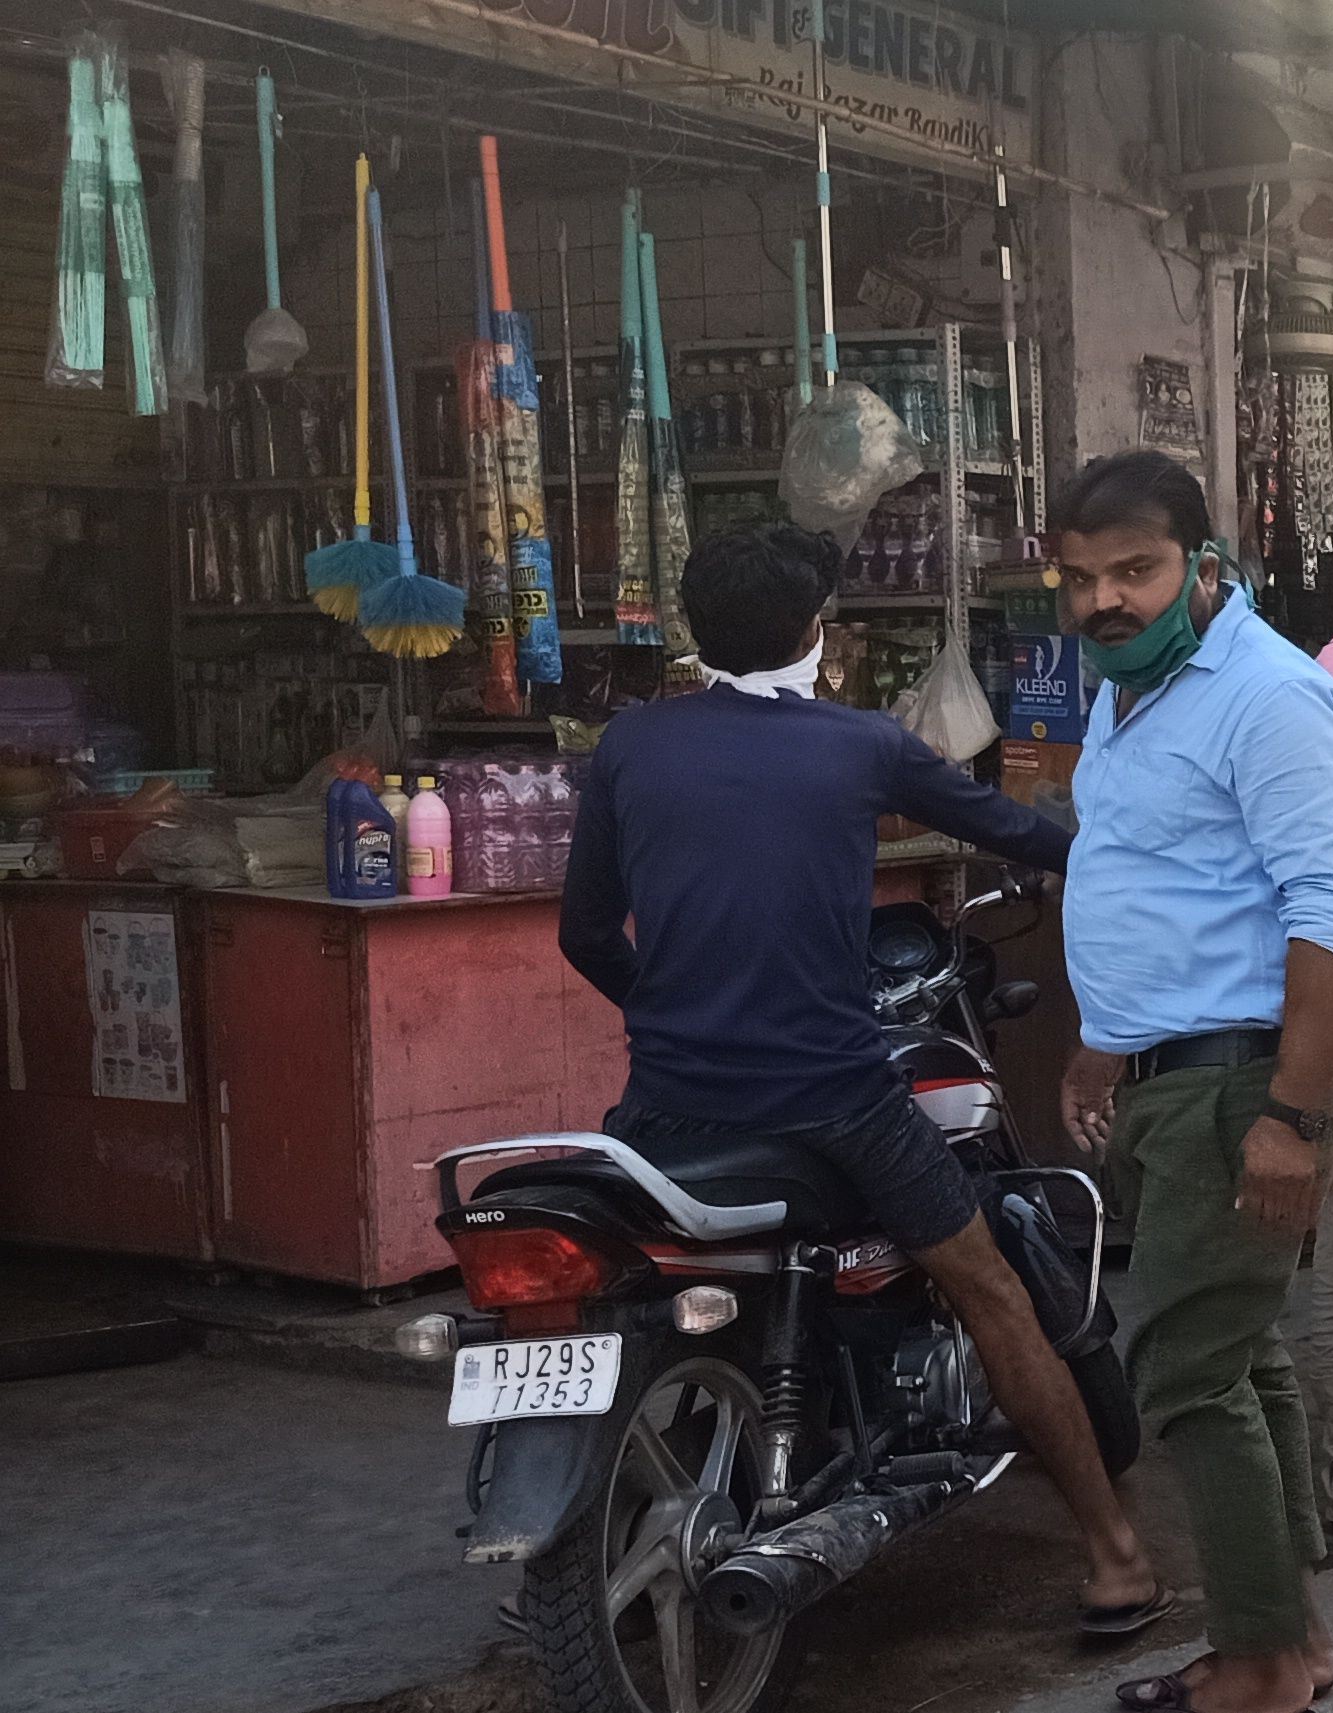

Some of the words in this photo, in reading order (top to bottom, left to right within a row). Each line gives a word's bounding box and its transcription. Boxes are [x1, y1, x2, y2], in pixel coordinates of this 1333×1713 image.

[1016, 678, 1067, 696] KLEENO
[465, 1210, 505, 1224] Hero
[838, 1247, 862, 1273] HF
[493, 1341, 596, 1380] RJ29S
[491, 1378, 594, 1415] T1353
